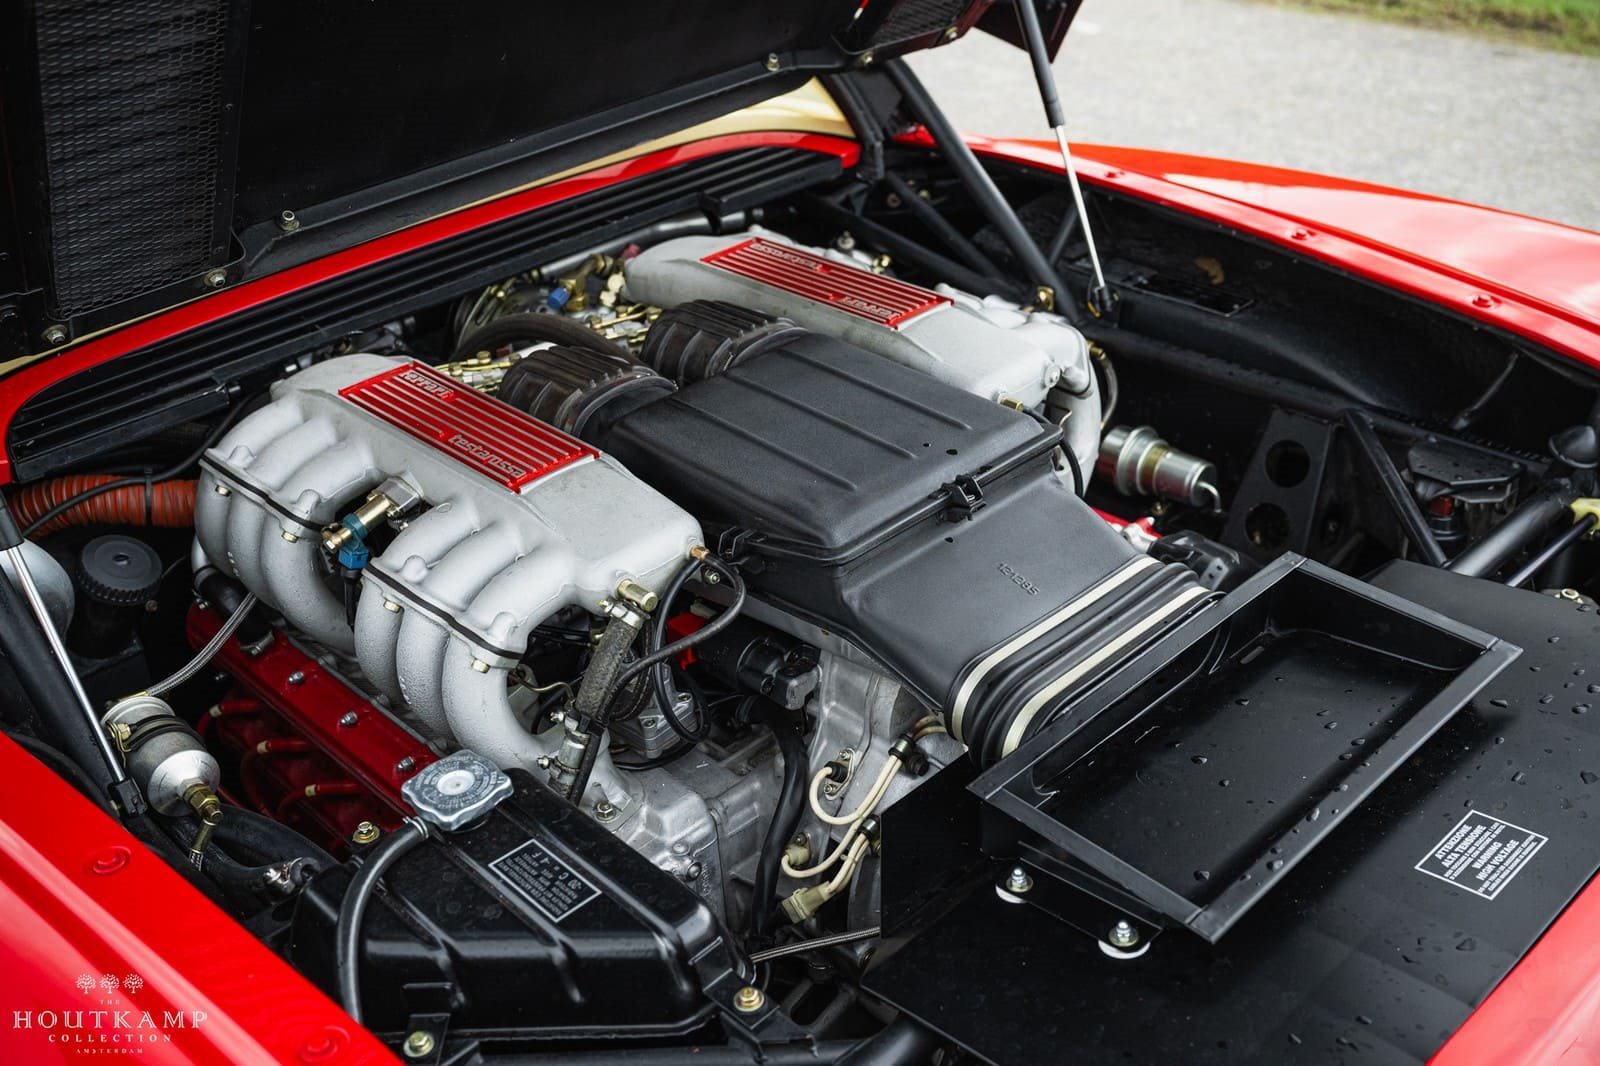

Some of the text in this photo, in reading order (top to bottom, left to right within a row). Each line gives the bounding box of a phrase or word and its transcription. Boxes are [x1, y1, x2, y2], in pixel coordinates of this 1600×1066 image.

[1434, 823, 1473, 860] ATTENZIONE
[1441, 852, 1461, 868] ALTA
[1454, 824, 1487, 853] TENSIONE
[1471, 841, 1503, 869] WARNING
[1476, 864, 1495, 881] HIGH
[1490, 839, 1520, 866] VOLTAGE
